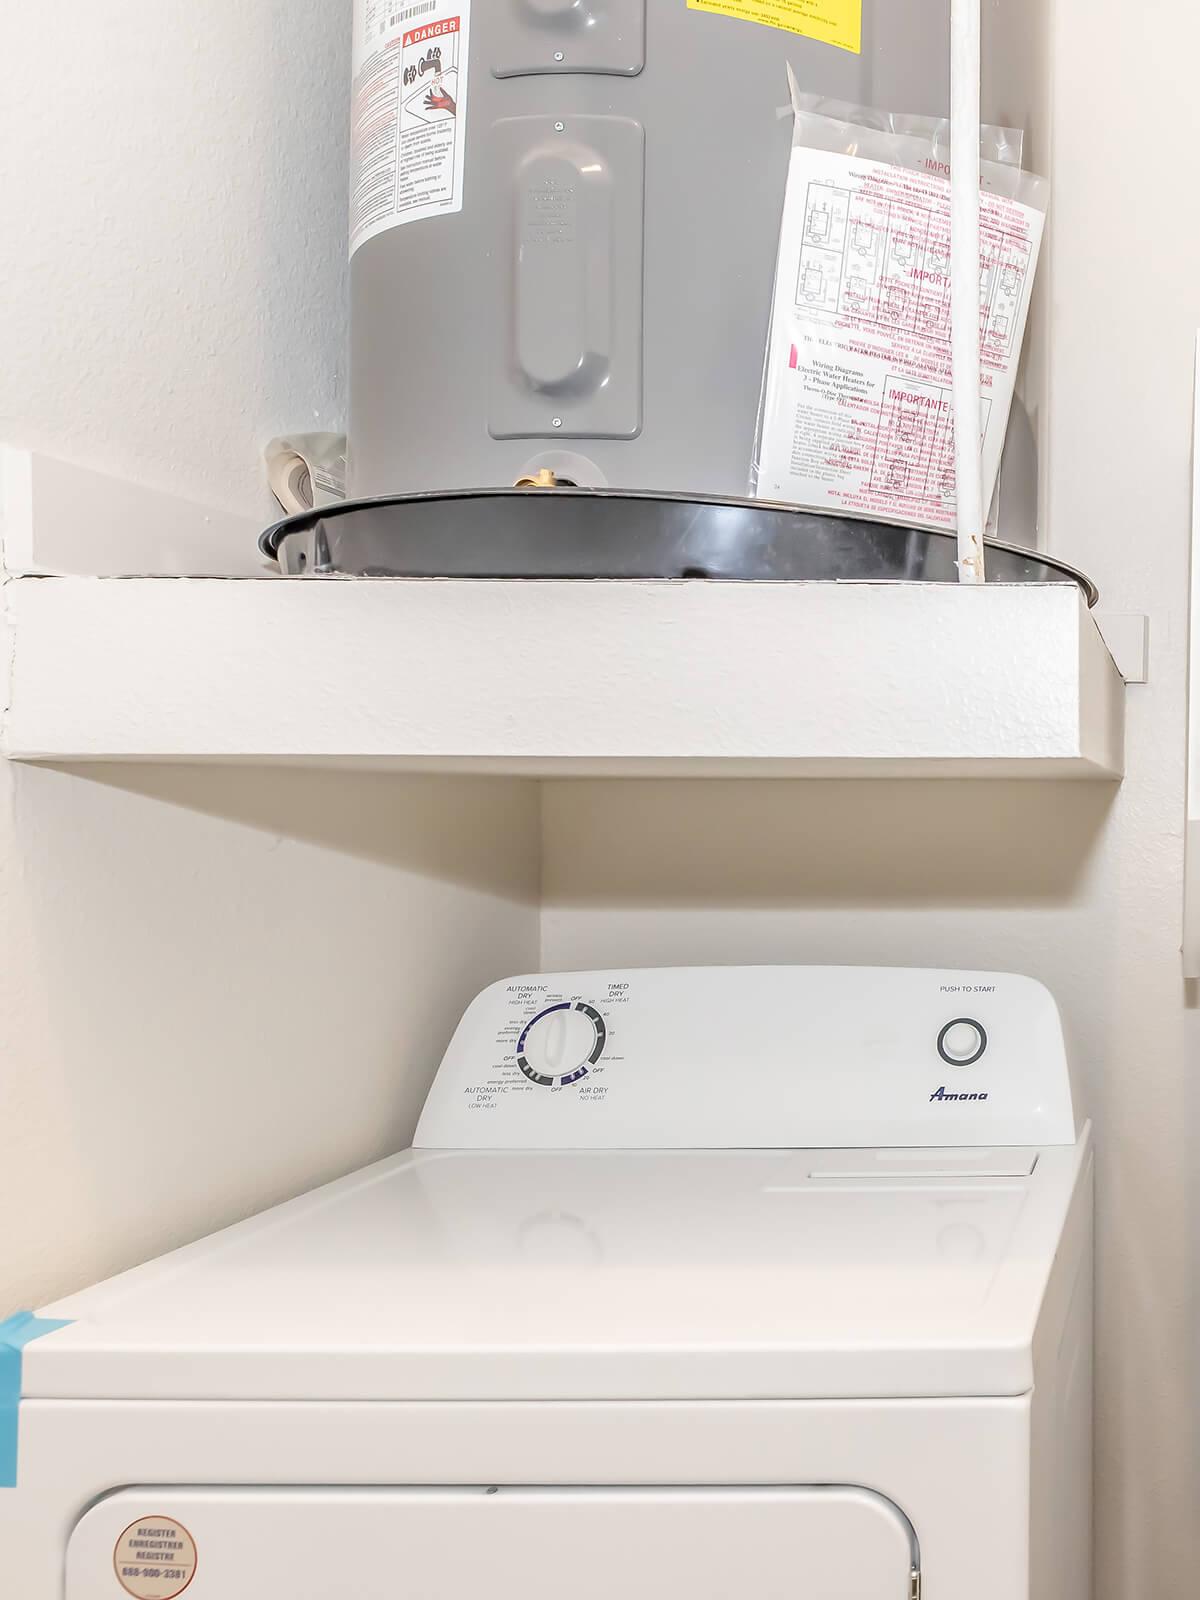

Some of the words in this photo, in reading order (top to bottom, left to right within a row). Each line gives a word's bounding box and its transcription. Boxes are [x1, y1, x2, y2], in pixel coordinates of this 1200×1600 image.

[414, 20, 457, 42] DANGER
[812, 359, 835, 372] Wiring
[834, 364, 864, 377] Diagrams
[797, 365, 822, 377] Electric
[822, 371, 842, 381] Water
[842, 375, 865, 386] Heaters
[812, 376, 831, 386] Phase
[832, 381, 868, 395] Applications
[888, 388, 950, 413] IMPORTANTE
[506, 985, 549, 993] AUTOMATIC
[608, 990, 625, 998] DRY
[939, 985, 960, 993] PUSH
[962, 985, 972, 993] TO
[973, 985, 997, 993] START
[517, 992, 533, 1000] DRY
[464, 1086, 509, 1094] AUTOMATIC
[929, 1086, 989, 1102] Amana
[476, 1094, 493, 1102] DRY
[137, 1528, 176, 1538] REGISTER
[128, 1538, 184, 1550] ENREGISTRER
[136, 1551, 175, 1561] REGISTRE
